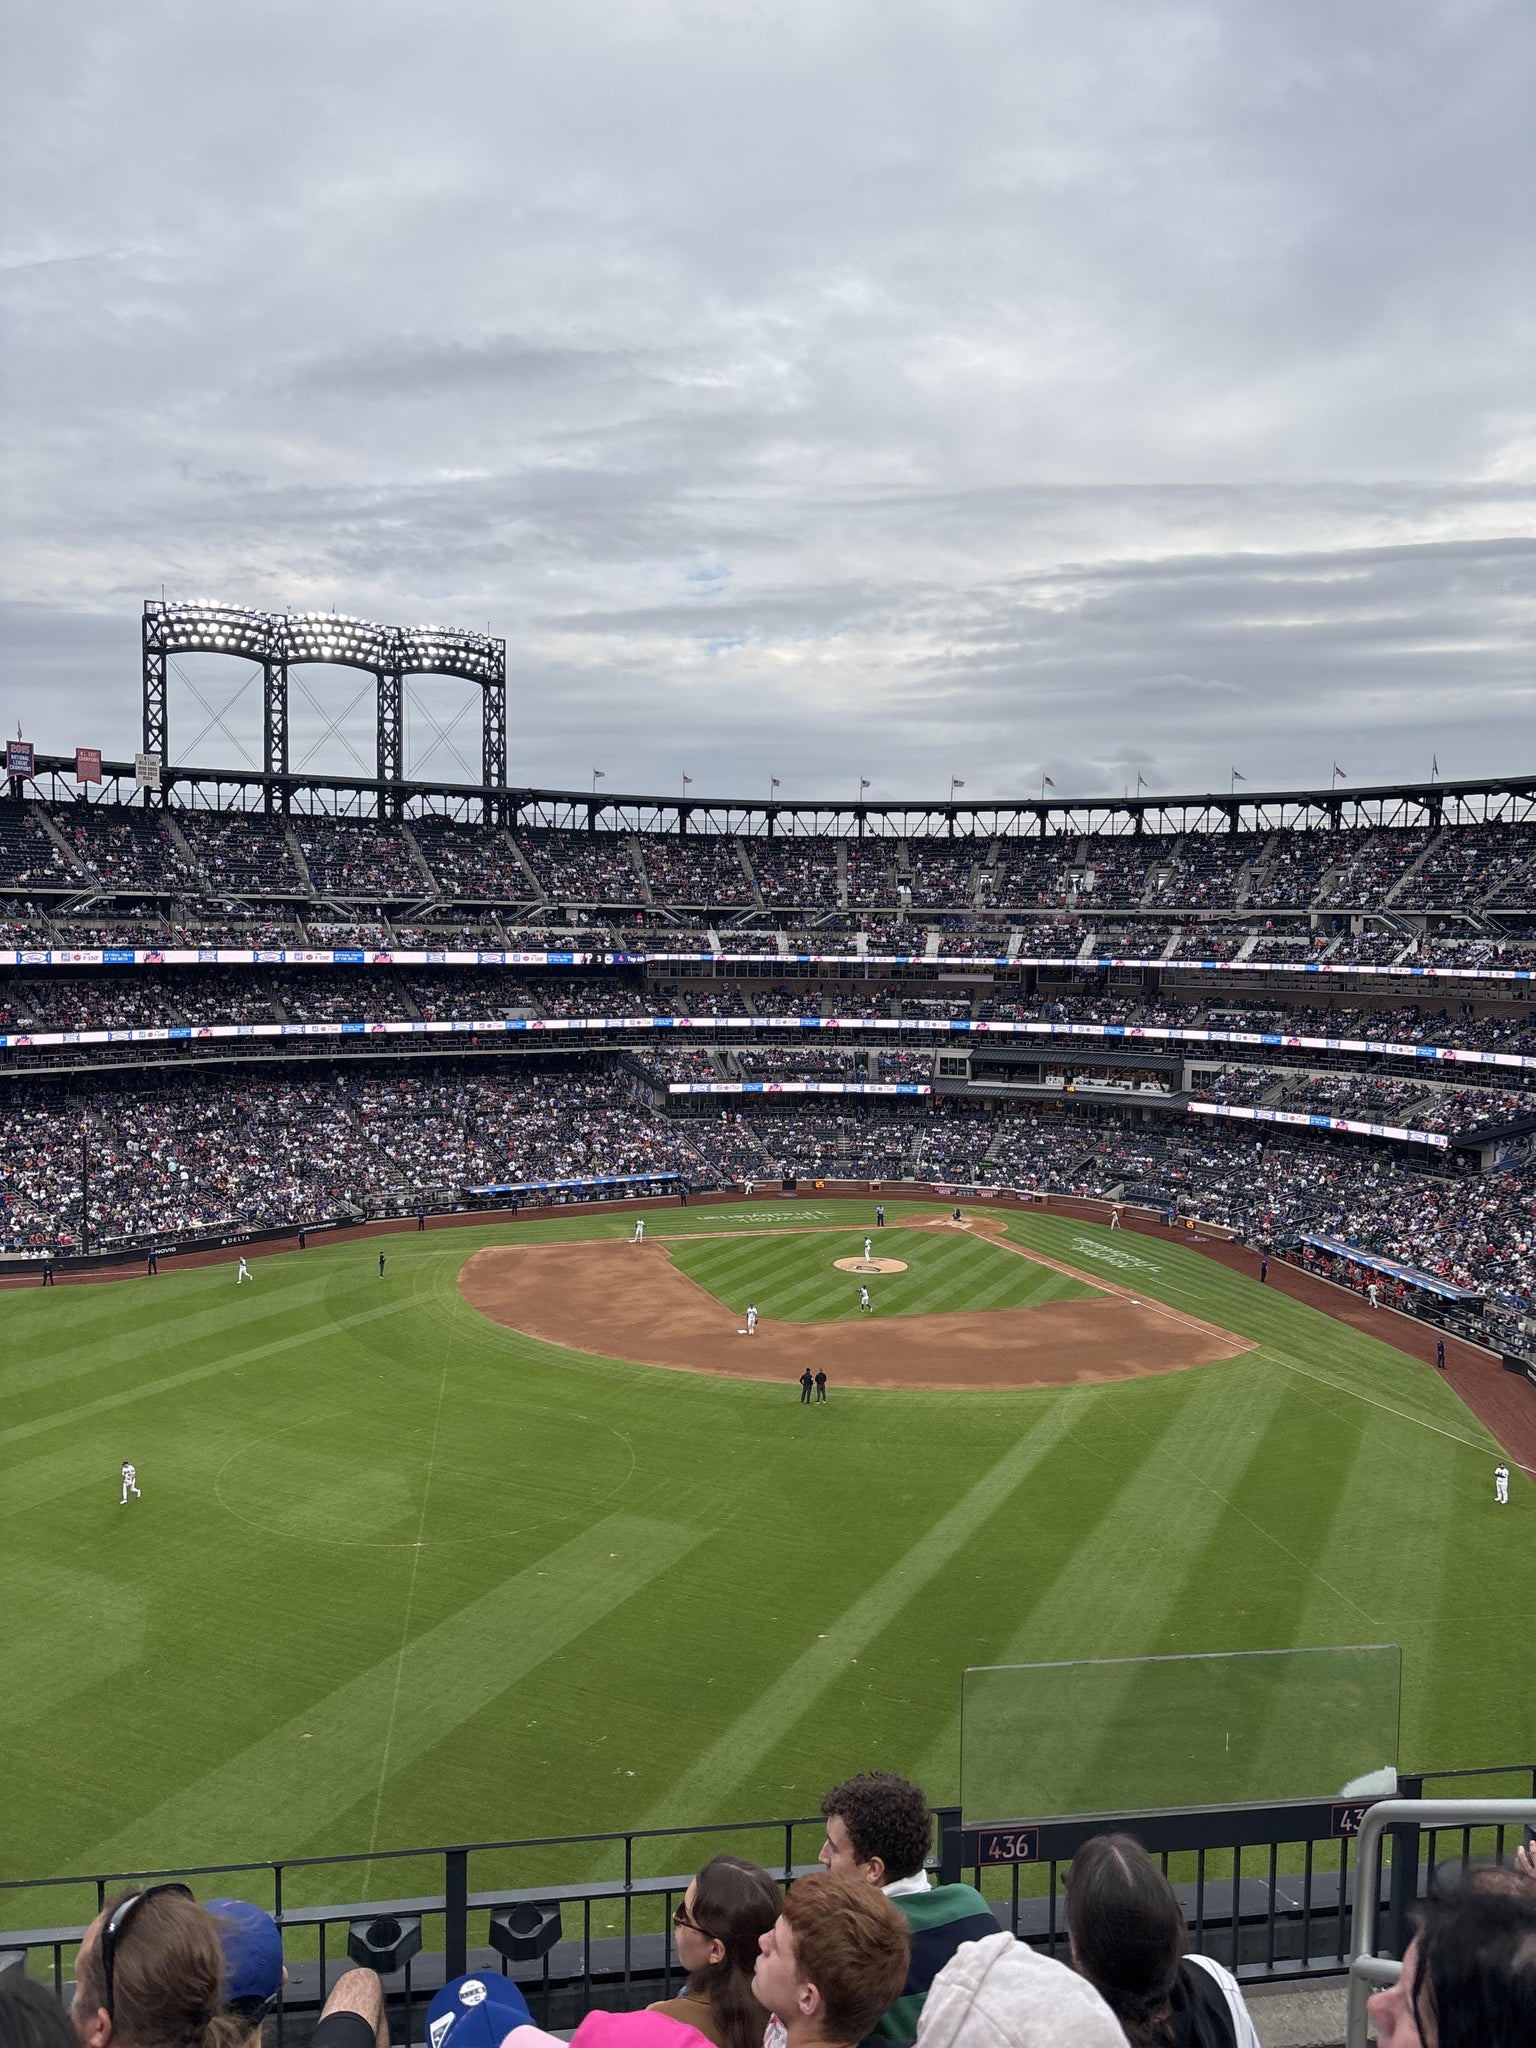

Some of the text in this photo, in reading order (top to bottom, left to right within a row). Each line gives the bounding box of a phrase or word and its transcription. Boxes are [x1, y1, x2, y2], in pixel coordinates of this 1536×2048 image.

[11, 744, 30, 754] 2015
[228, 1235, 250, 1243] DELTA
[155, 1246, 177, 1255] NOVIG
[989, 1834, 1028, 1859] 436
